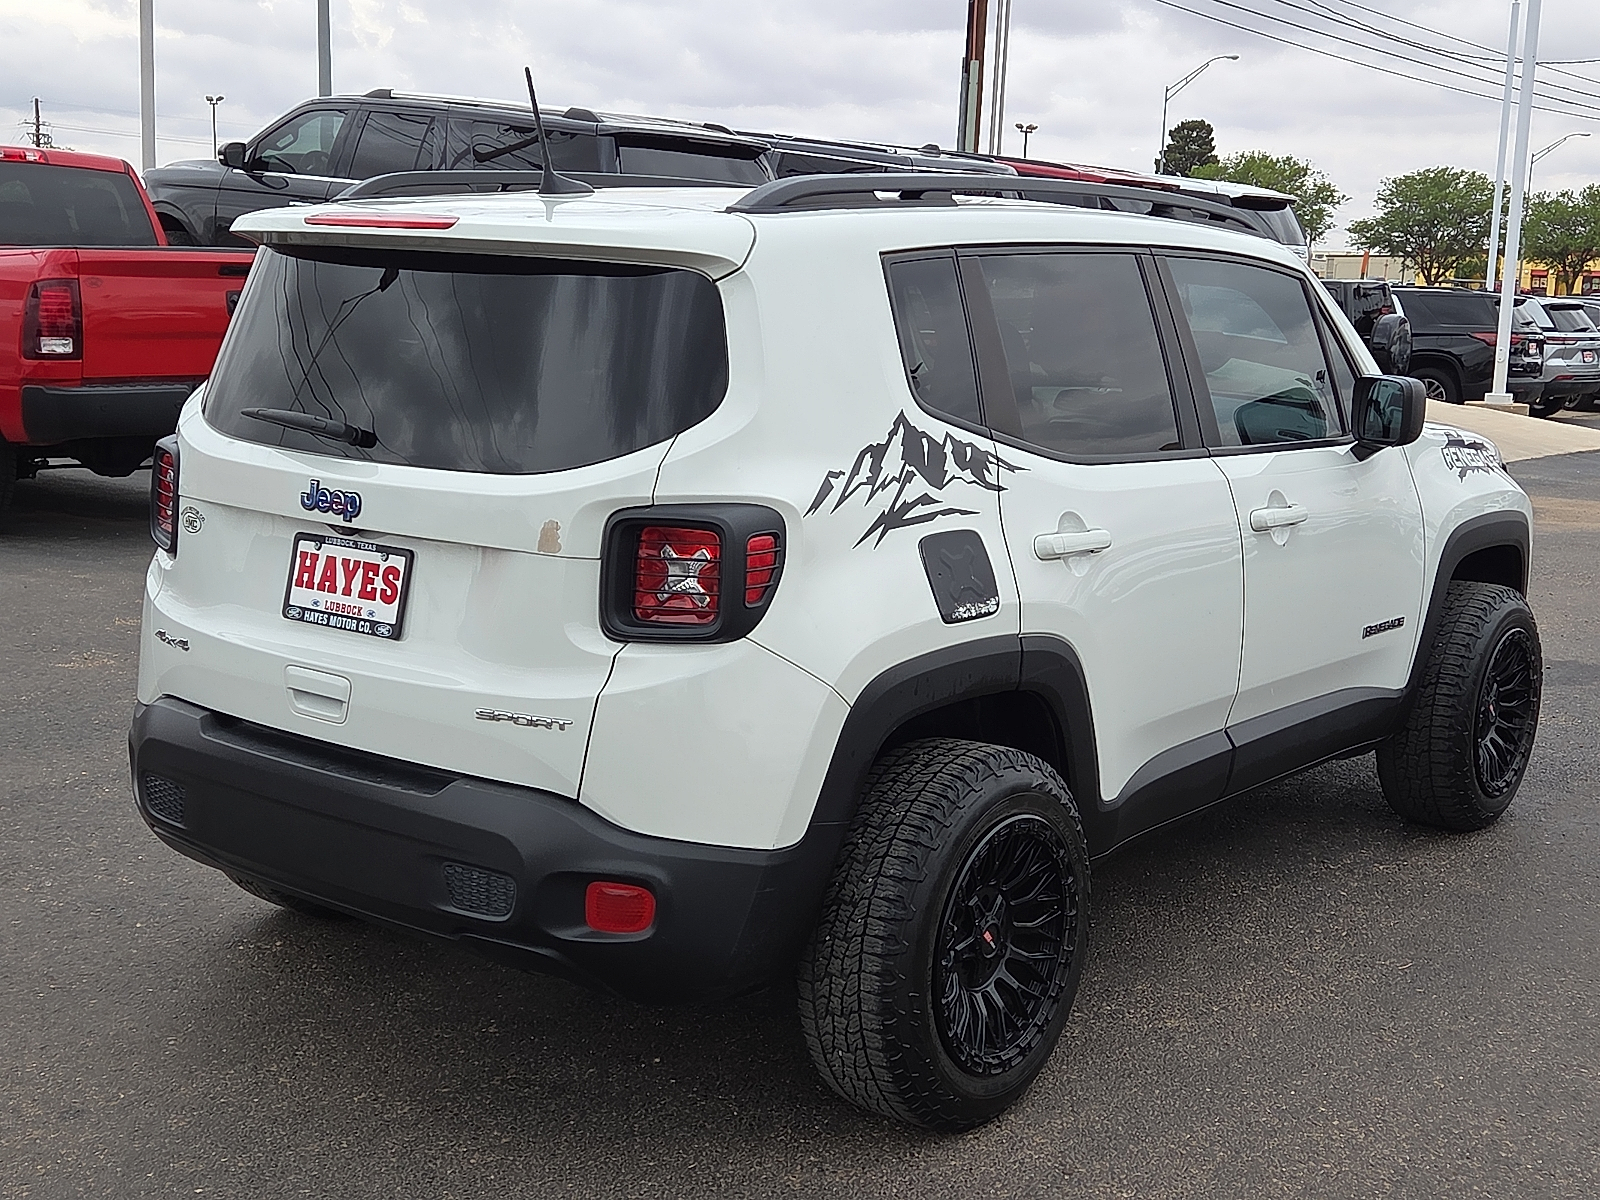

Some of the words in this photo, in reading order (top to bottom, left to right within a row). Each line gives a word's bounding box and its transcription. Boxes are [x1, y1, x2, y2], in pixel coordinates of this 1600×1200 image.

[301, 479, 361, 522] Jeep
[357, 542, 377, 551] TEXAS
[294, 550, 401, 605] HAYES
[324, 600, 363, 617] LUBBOCK
[304, 610, 328, 625] HAYES
[329, 616, 357, 630] MOTOR
[358, 621, 372, 634] CO.
[475, 708, 573, 731] SPORT
